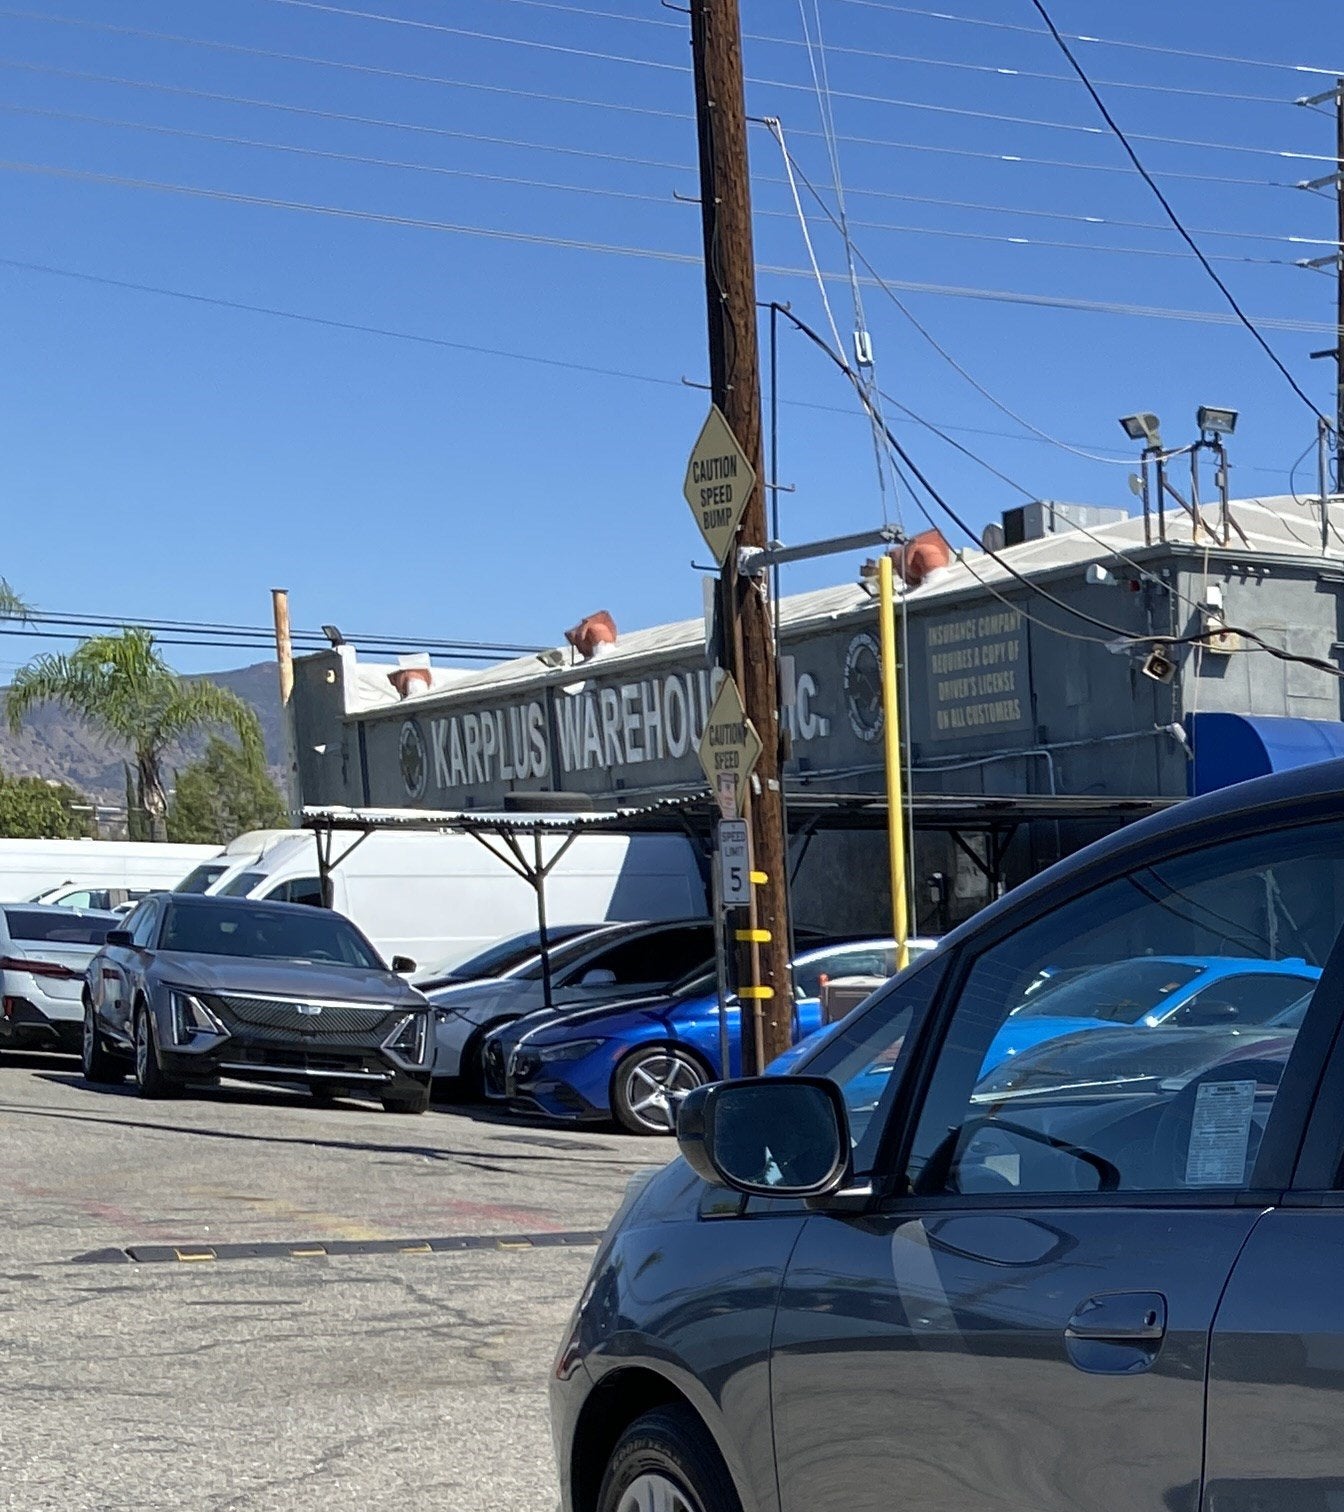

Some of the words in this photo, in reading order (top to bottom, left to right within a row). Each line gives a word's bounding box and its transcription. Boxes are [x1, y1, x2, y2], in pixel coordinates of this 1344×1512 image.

[692, 454, 738, 484] CAUTION
[700, 483, 733, 508] SPEED
[703, 507, 733, 530] BUMP
[928, 616, 976, 646] INSURANCE
[978, 610, 1021, 637] COMPANY
[932, 648, 973, 674] REQUIRES
[982, 642, 1007, 665] COPY
[1008, 640, 1020, 661] OF
[978, 670, 1015, 695] LICENSE
[937, 710, 950, 730] ON
[951, 707, 965, 727] ALL
[966, 699, 1021, 725] CUSTOMERS
[431, 702, 547, 789] KARPLUS
[555, 667, 726, 772] WAREHOU
[709, 723, 747, 748] CAUTION
[714, 750, 740, 770] SPEED
[721, 831, 746, 843] SPEED
[724, 845, 745, 858] LIMIT
[730, 867, 742, 892] 5
